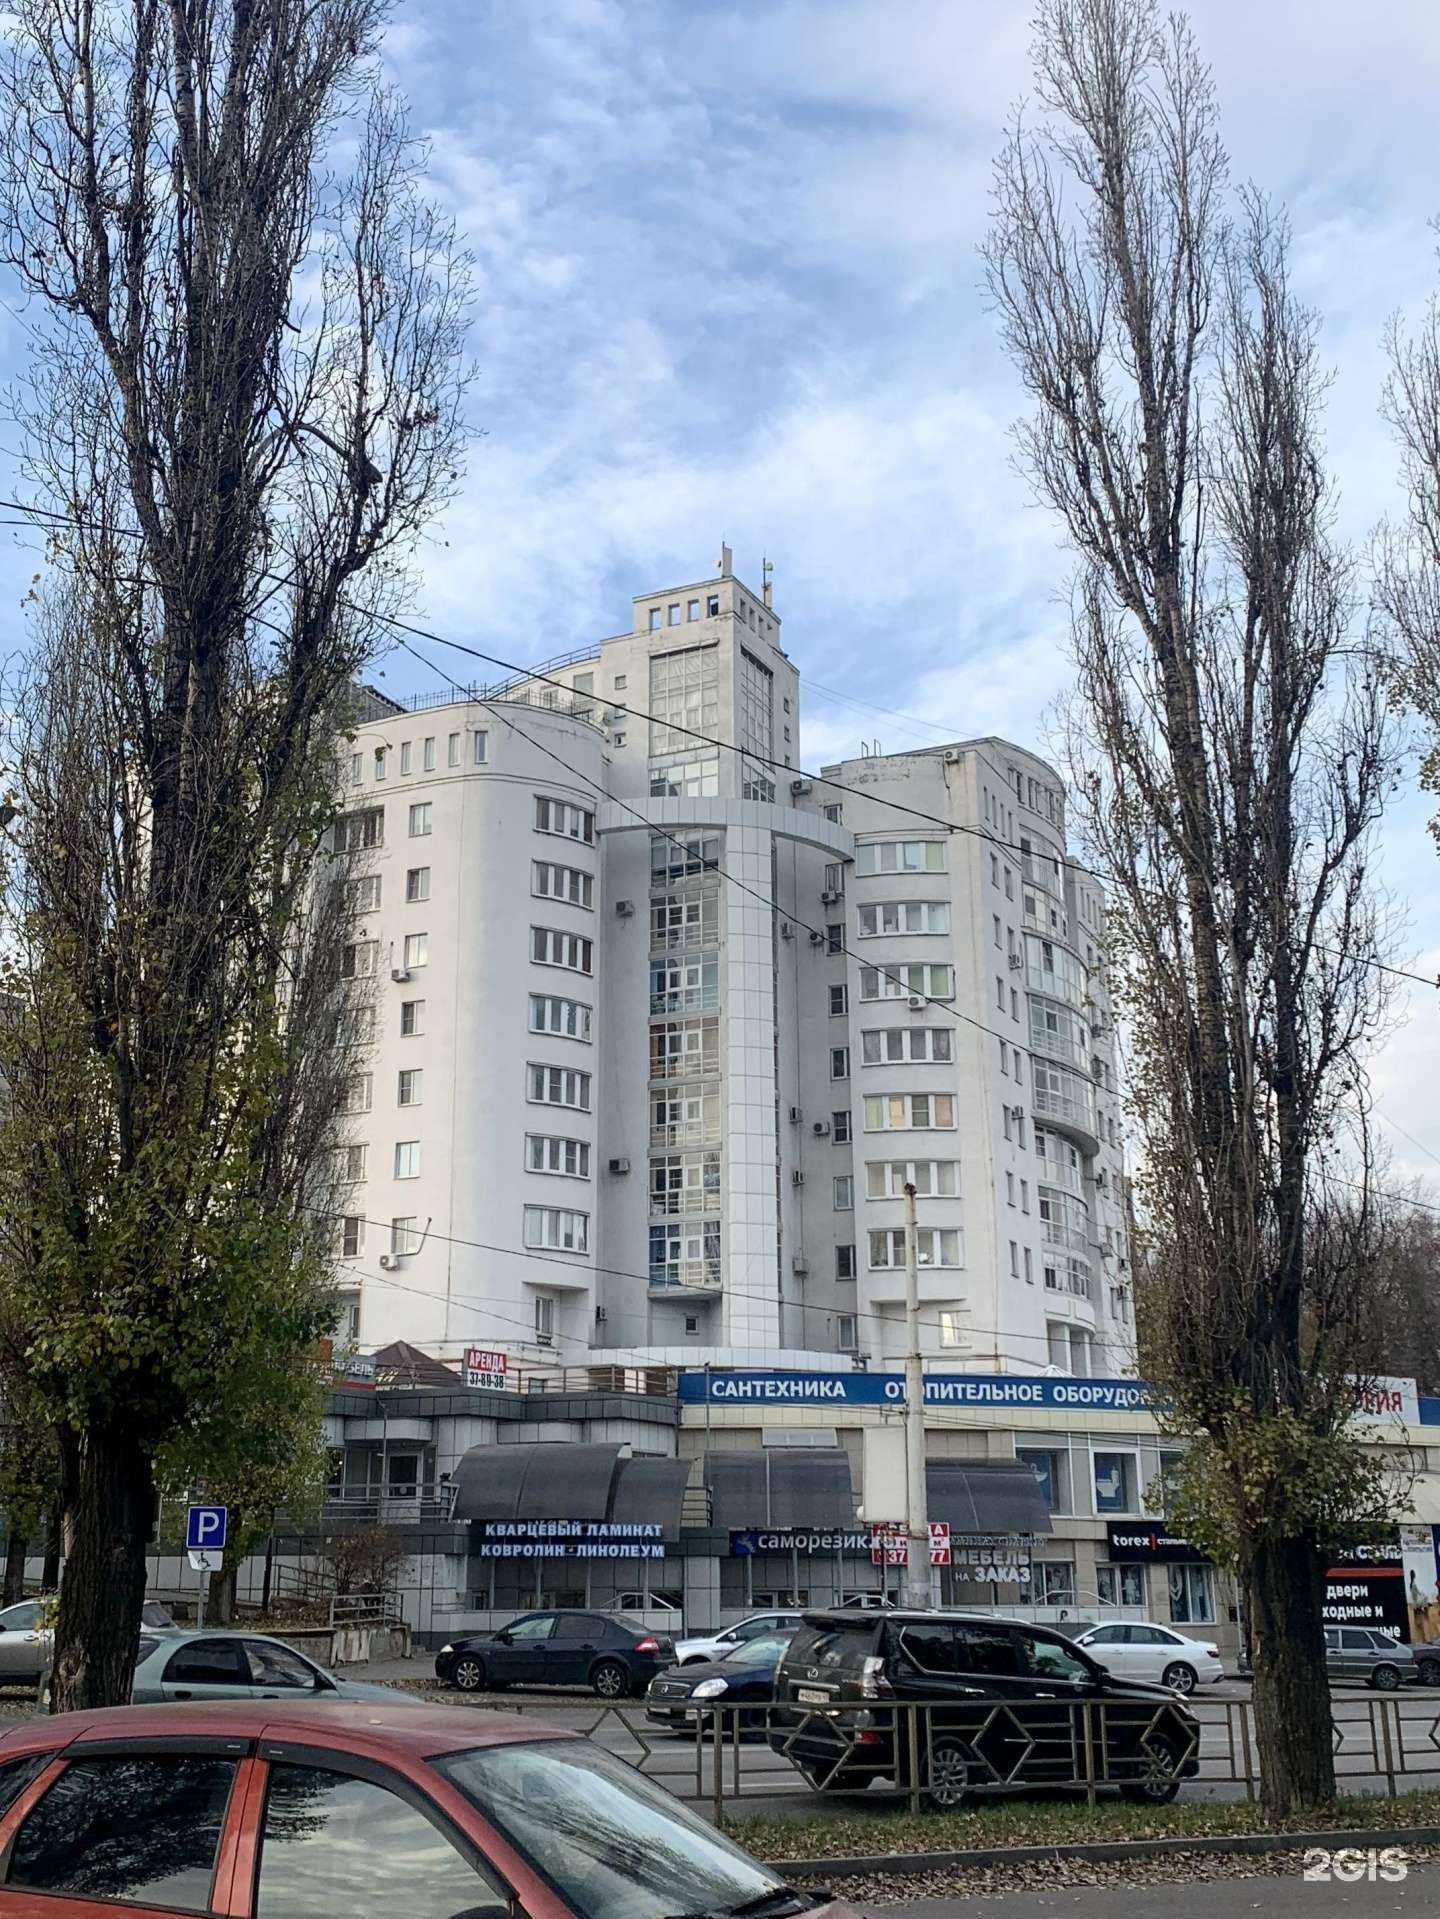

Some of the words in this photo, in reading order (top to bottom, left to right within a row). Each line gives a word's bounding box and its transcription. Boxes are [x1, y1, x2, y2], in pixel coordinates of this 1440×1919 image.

[468, 1352, 505, 1373] АРЕНДА
[469, 1371, 505, 1389] 37-89-38
[711, 1380, 846, 1398] САНТЕХНИКА
[884, 1380, 1043, 1402] ОТПИТЕЛЬНОЕ
[198, 1511, 220, 1543] P
[485, 1521, 581, 1538] КВАРЦЕВЫЙ
[586, 1523, 663, 1537] ЛАМИНАТ
[1112, 1533, 1150, 1546] torex
[481, 1544, 565, 1558] КОВРОЛИН
[576, 1544, 665, 1558] ЛИНОЛЕУМ
[953, 1549, 1030, 1565] МЕБЕЛЬ
[974, 1566, 1031, 1583] ЗАКАЗ
[1326, 1585, 1369, 1600] двери
[1322, 1605, 1372, 1620] ходные
[1375, 1605, 1384, 1617] и
